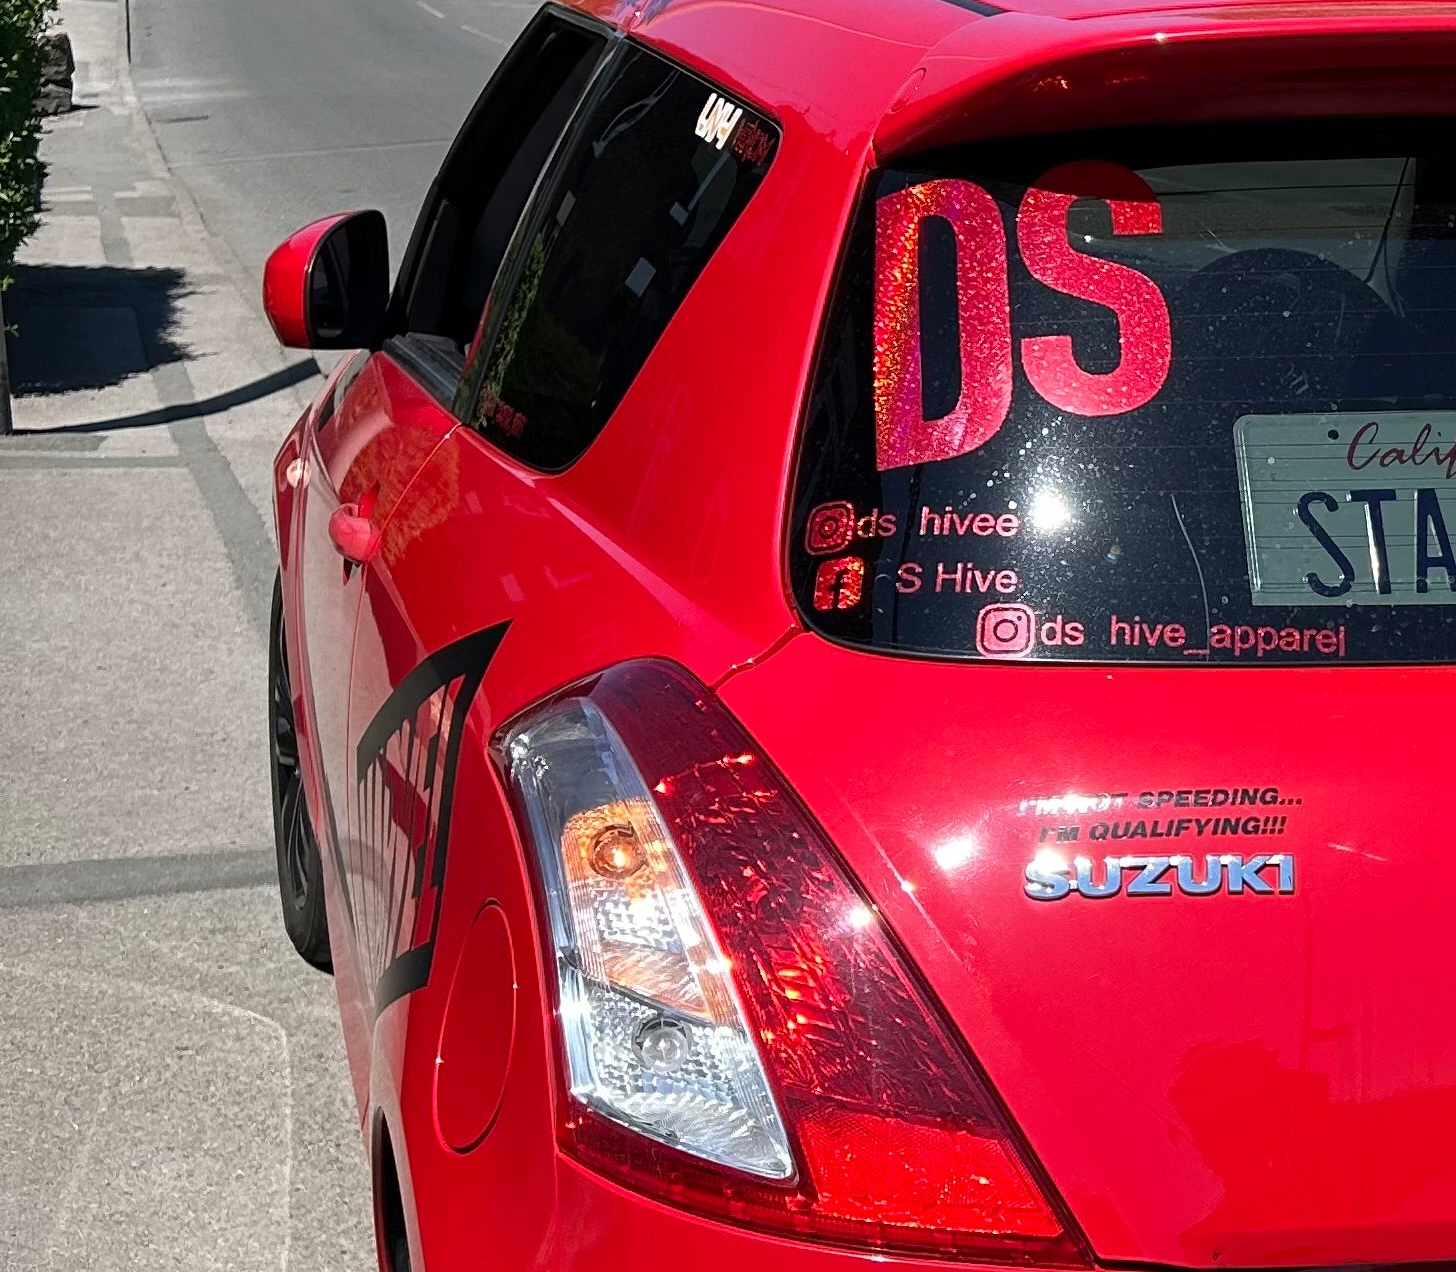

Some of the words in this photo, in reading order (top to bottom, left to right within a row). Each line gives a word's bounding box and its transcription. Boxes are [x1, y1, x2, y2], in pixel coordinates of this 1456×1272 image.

[874, 160, 1171, 472] DS
[856, 507, 897, 538] ds
[919, 506, 1020, 537] hivee
[935, 562, 1018, 593] Hive
[1040, 615, 1085, 646] ds
[1137, 788, 1303, 810] SPEEDING...
[1040, 825, 1079, 843] I'M
[1089, 816, 1287, 841] QUALIFYING!!!
[1025, 855, 1295, 899] SUZUKI
